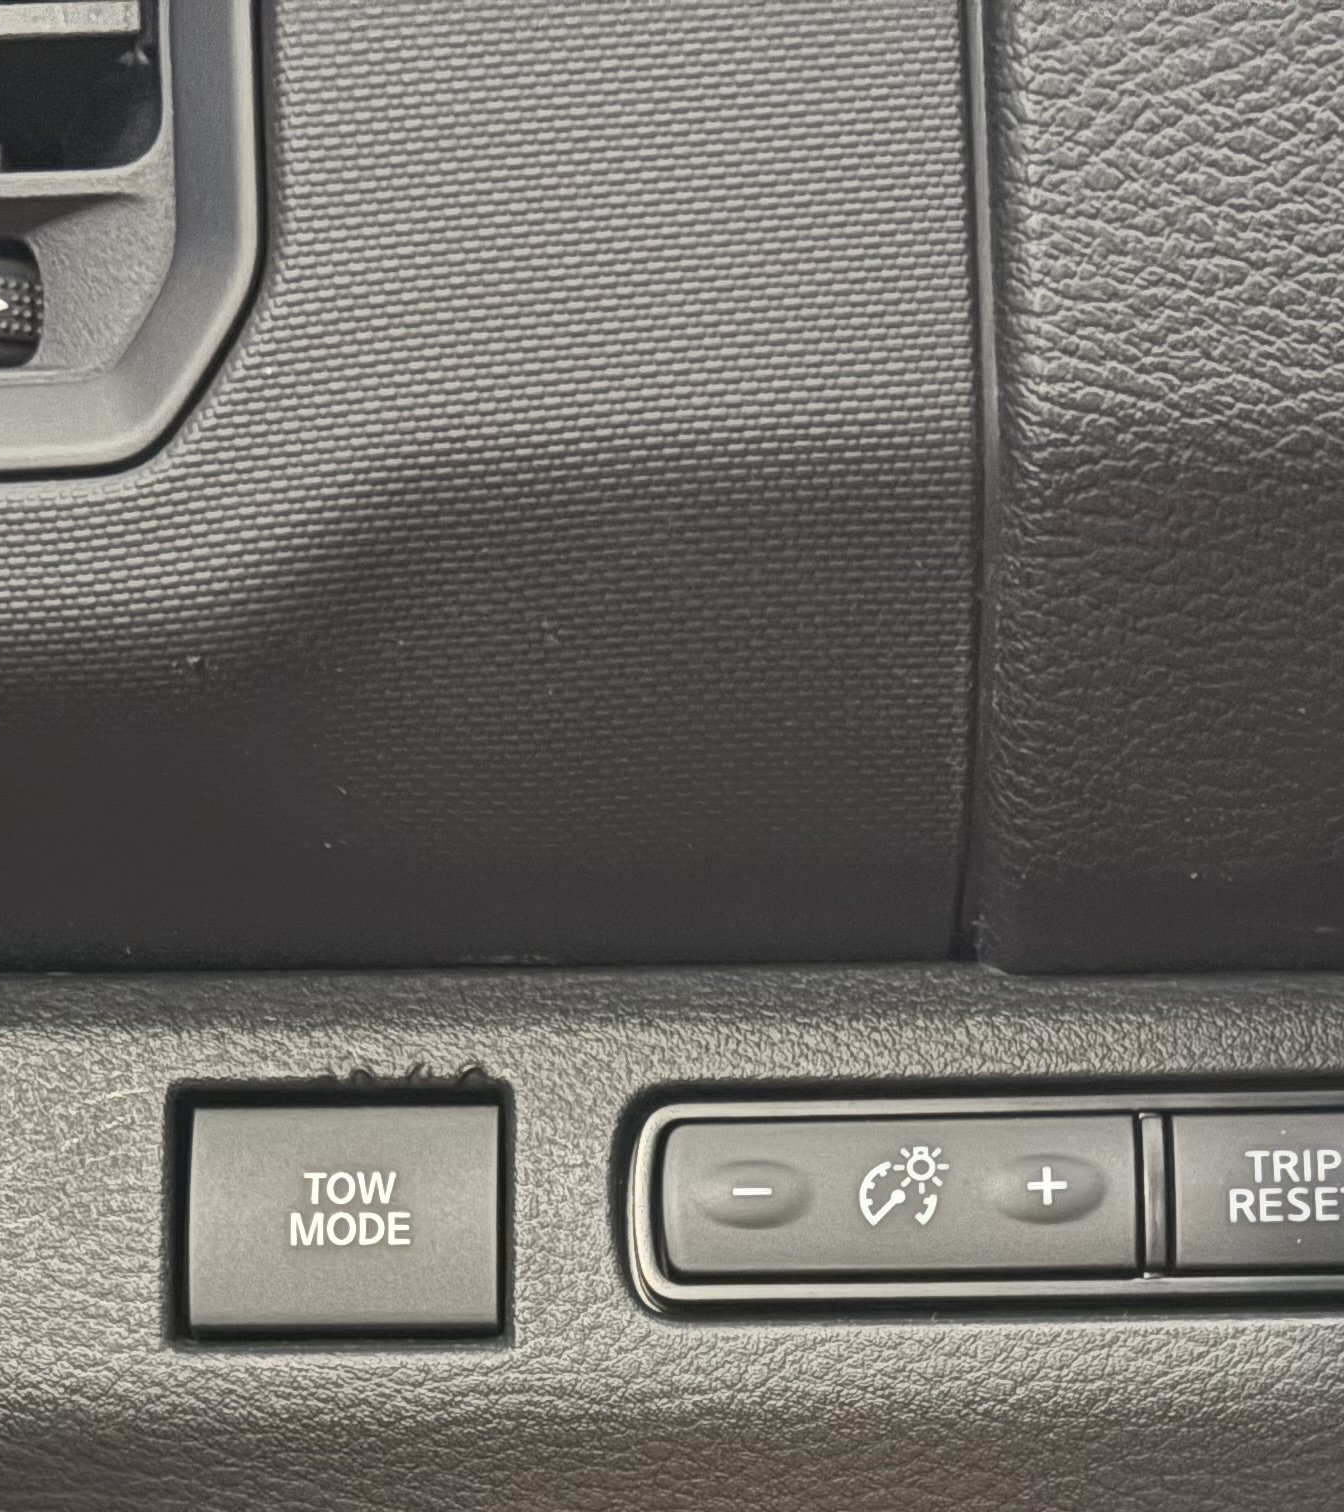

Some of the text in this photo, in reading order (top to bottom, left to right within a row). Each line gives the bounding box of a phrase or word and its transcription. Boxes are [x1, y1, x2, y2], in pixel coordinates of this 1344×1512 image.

[1243, 1148, 1343, 1184] TRIP
[302, 1170, 398, 1206] TOW
[289, 1210, 412, 1247] MODE
